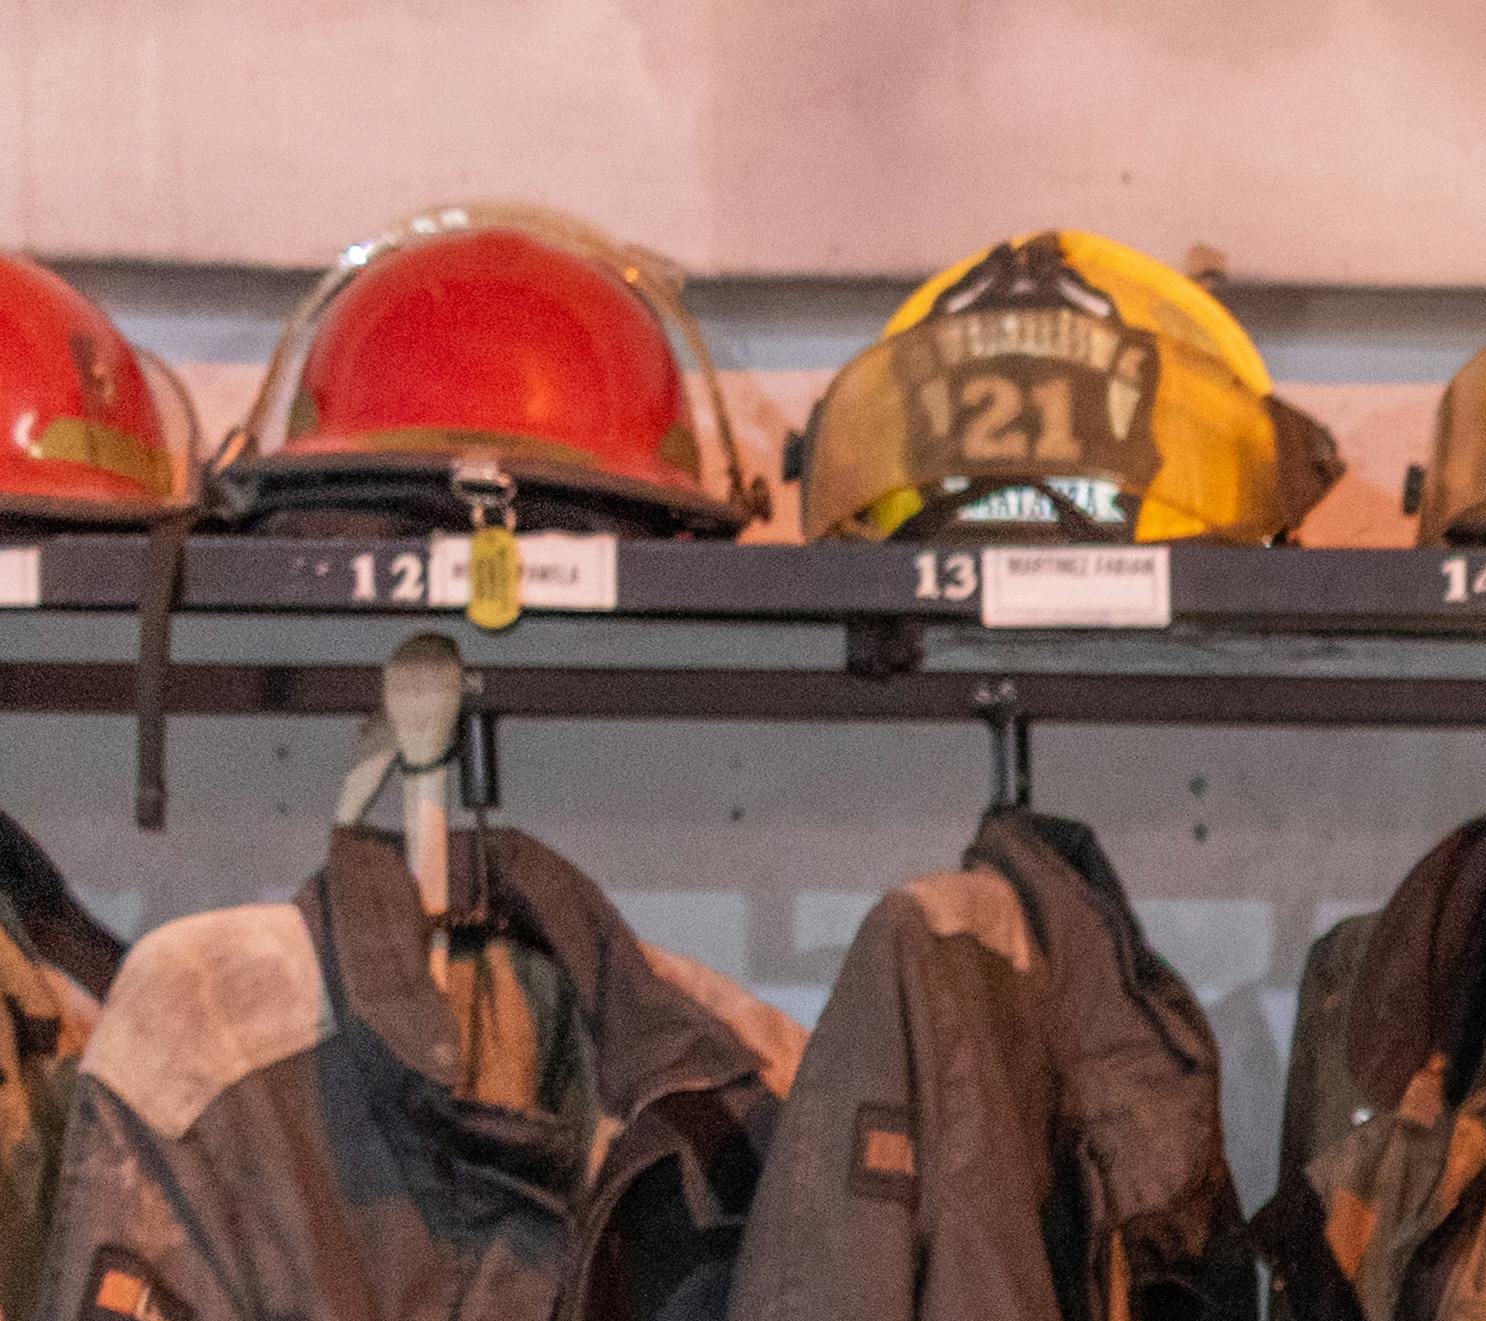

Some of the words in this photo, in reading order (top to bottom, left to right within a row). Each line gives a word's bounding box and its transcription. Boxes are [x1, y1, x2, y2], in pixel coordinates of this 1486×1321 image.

[960, 375, 1082, 459] 21
[352, 552, 425, 601] 12
[915, 552, 977, 600] 13
